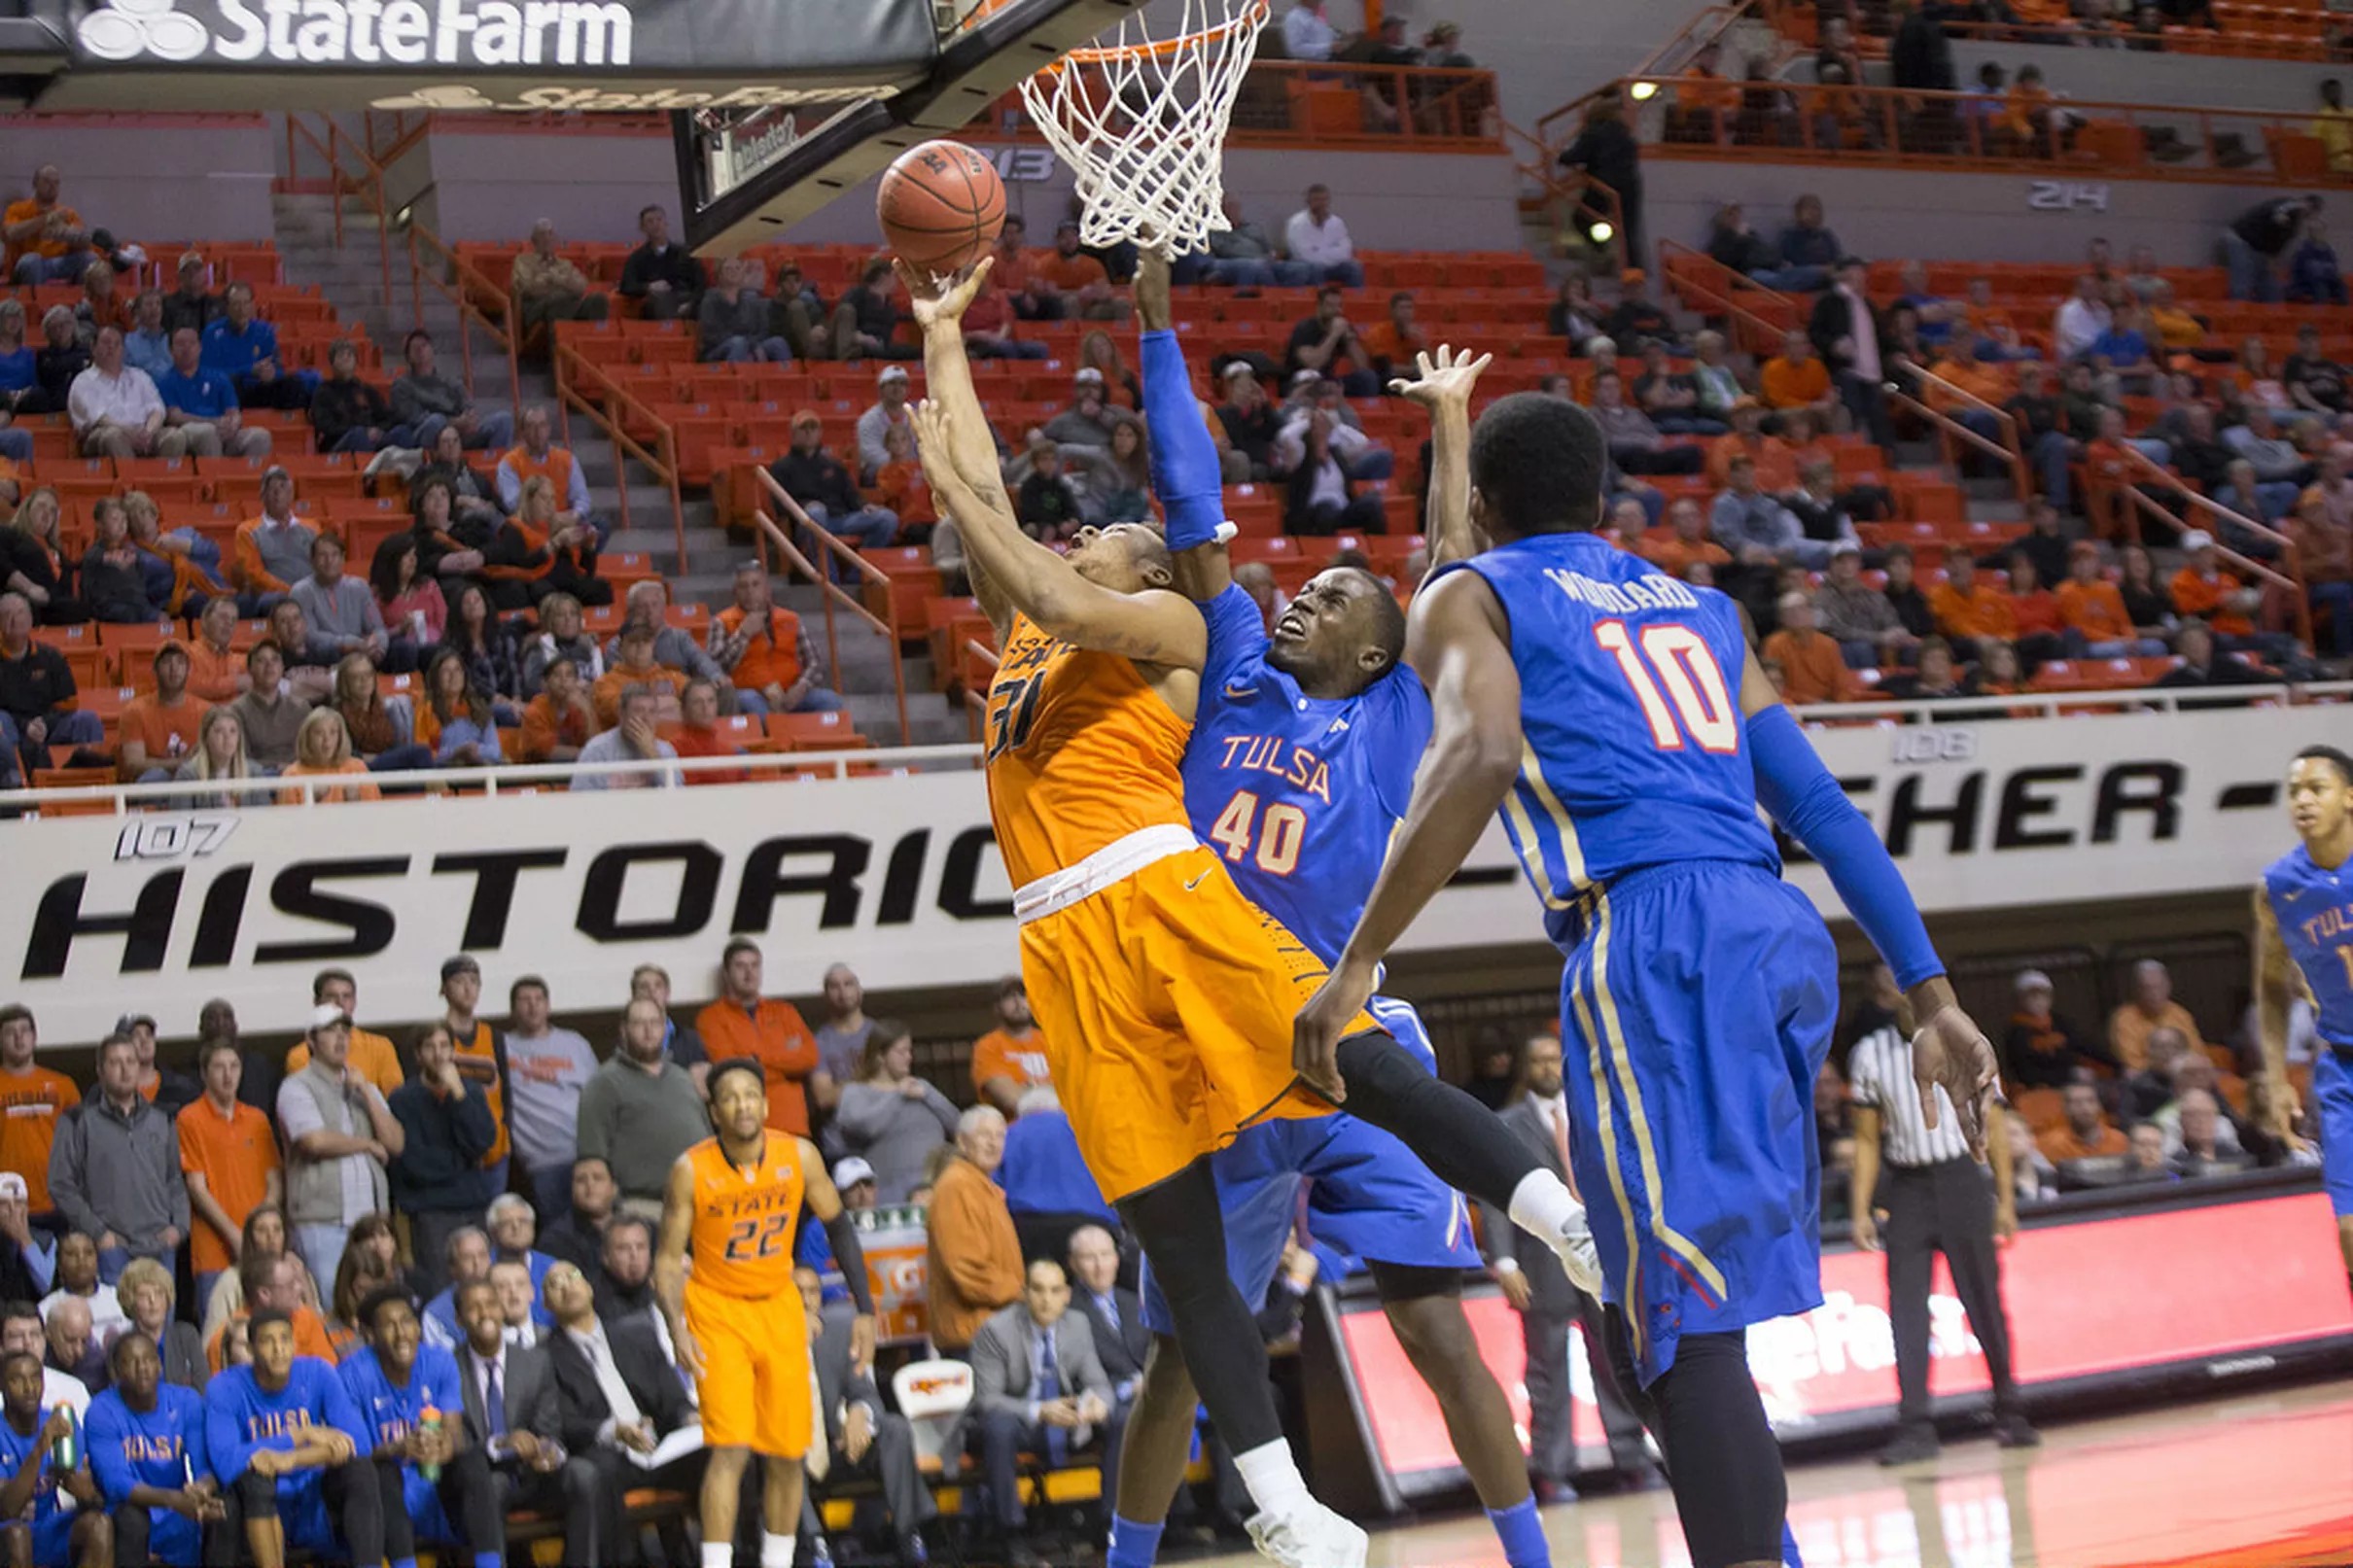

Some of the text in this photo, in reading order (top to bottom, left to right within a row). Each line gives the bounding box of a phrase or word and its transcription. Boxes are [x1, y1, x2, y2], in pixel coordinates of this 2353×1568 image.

[978, 148, 1055, 181] 13
[2027, 181, 2109, 212] 214
[1593, 618, 1738, 755] 10
[988, 668, 1048, 765] 31
[1221, 735, 1332, 805] TULSA
[114, 815, 242, 862] 107
[1211, 790, 1308, 877] 40
[2301, 902, 2353, 947] TUL
[724, 1212, 790, 1261] 22
